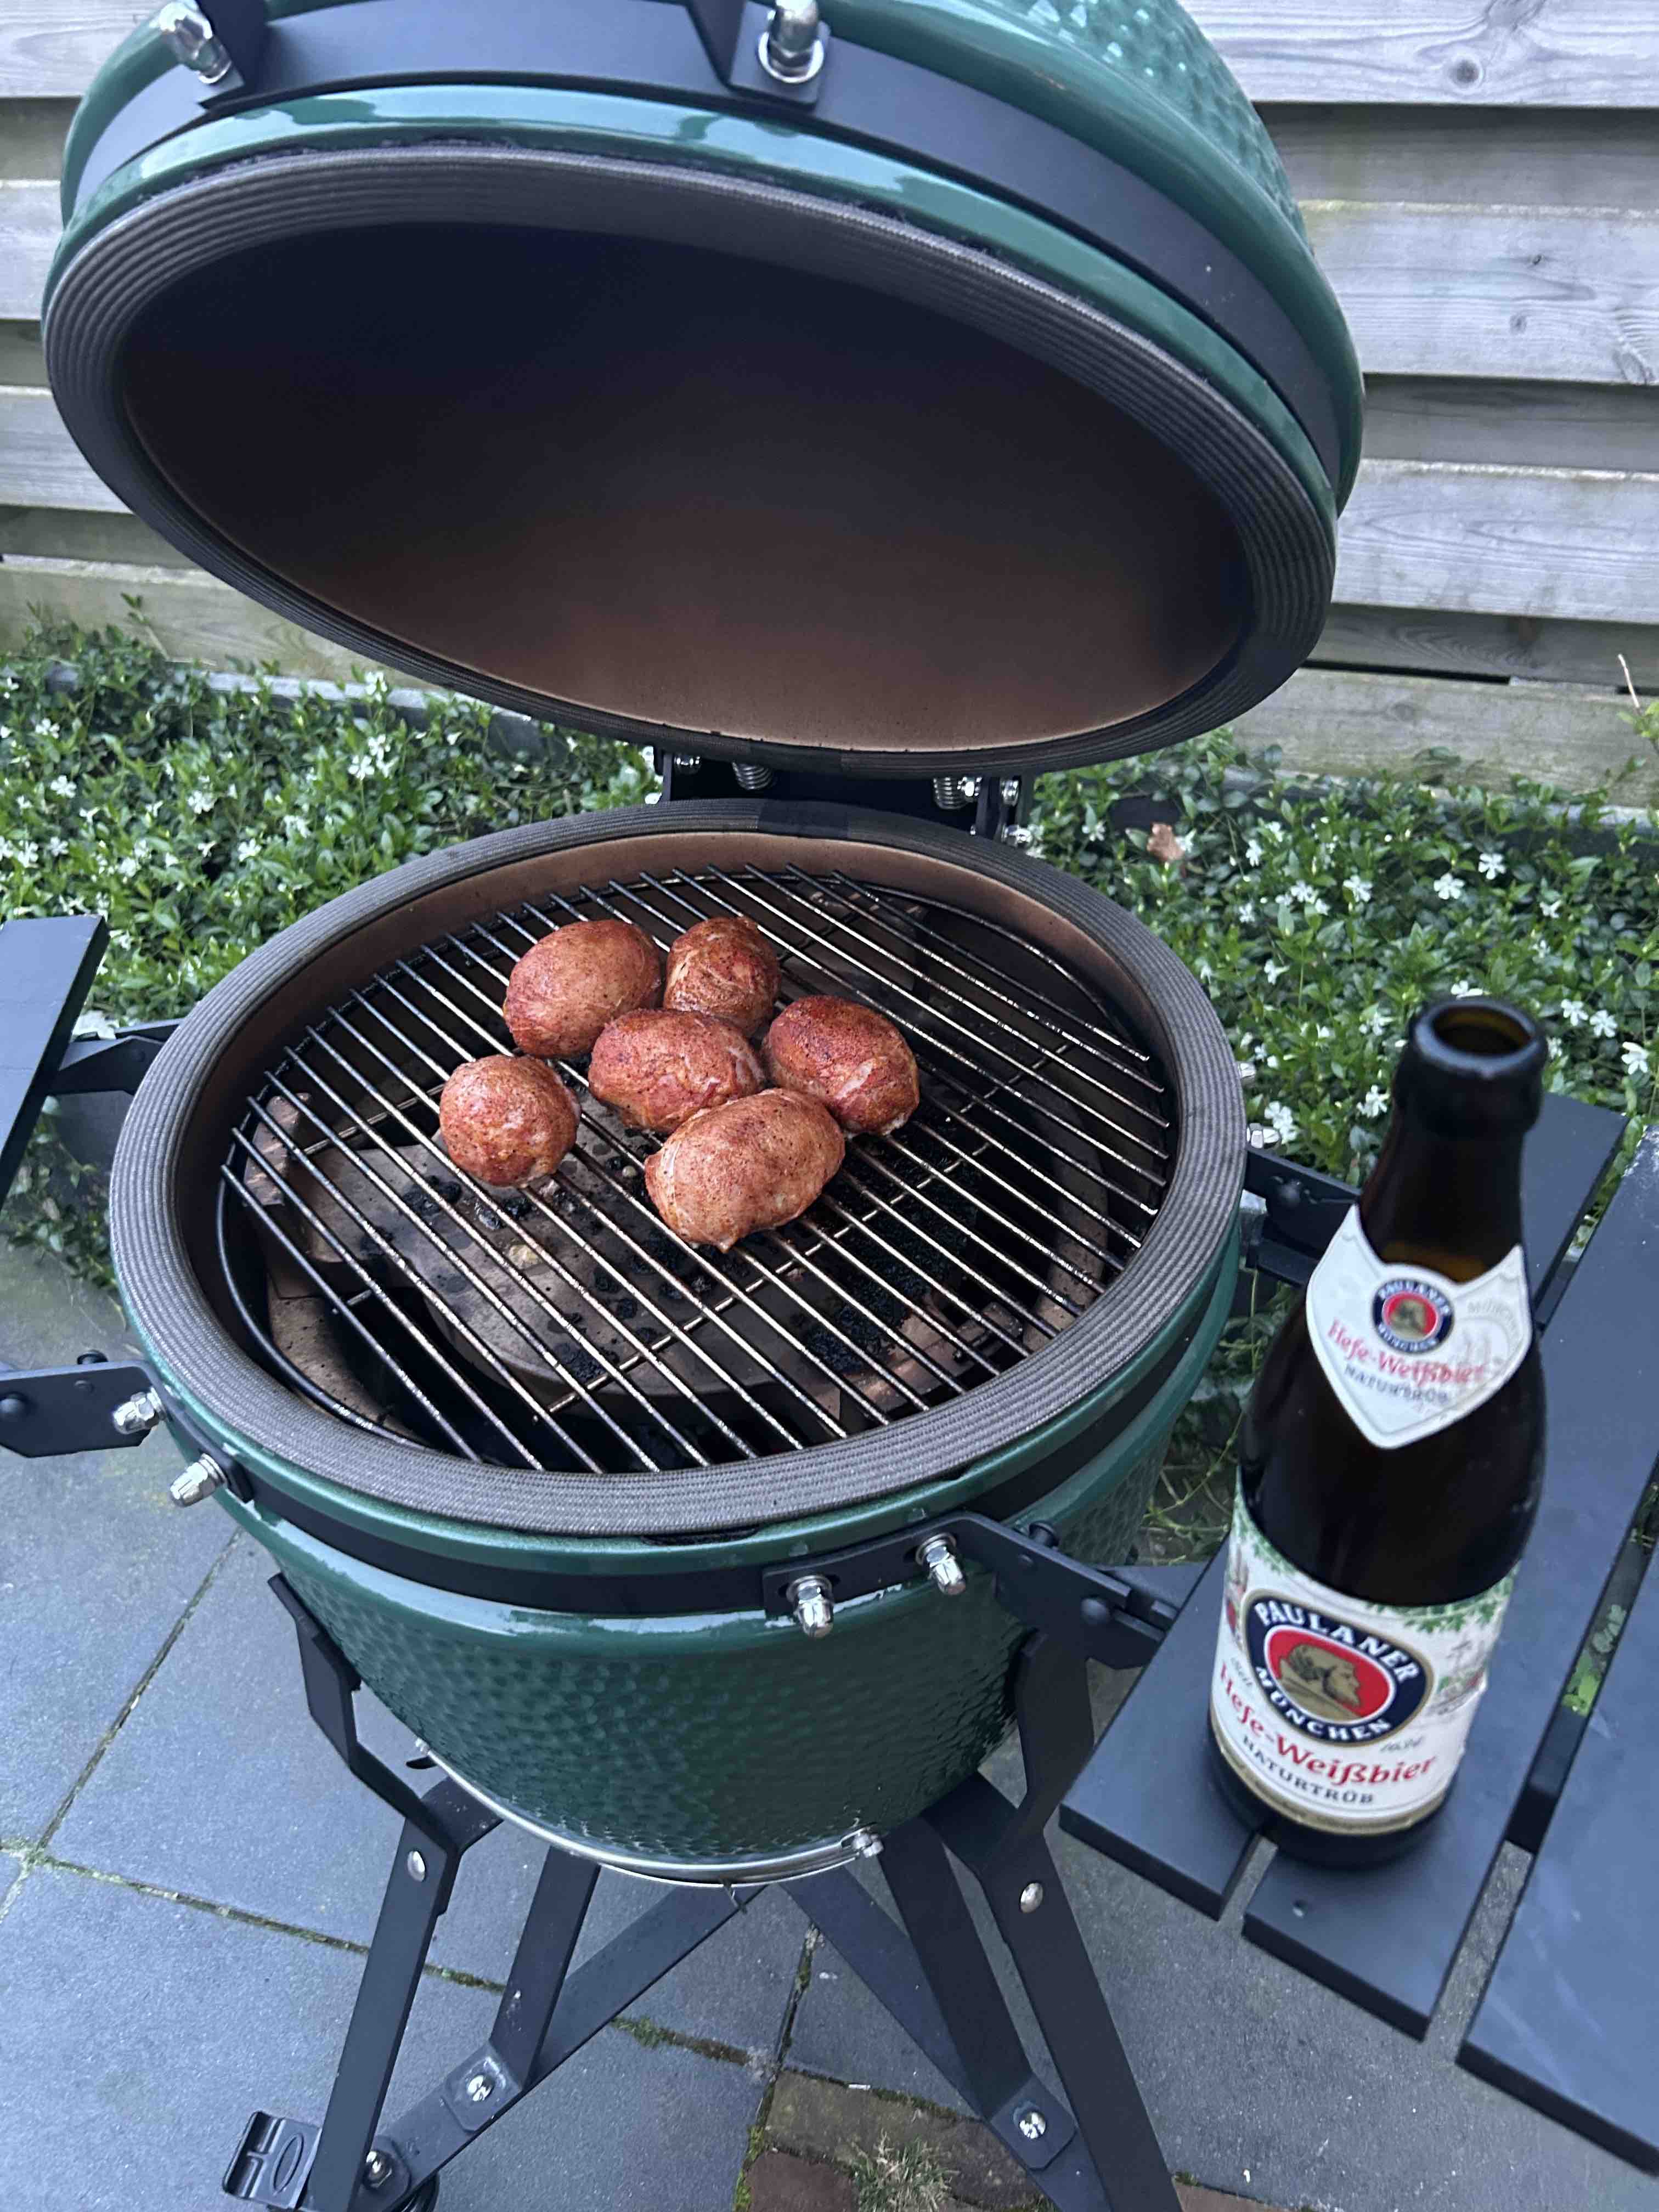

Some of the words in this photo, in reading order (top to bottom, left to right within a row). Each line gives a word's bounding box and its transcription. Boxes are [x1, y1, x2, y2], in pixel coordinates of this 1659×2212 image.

[1254, 1600, 1419, 1683] PAULANER
[1220, 1661, 1435, 1786] Hefe-Weißbier
[1256, 1666, 1391, 1741] MÜNCHEN
[1243, 1735, 1374, 1804] NATURTRÜB
